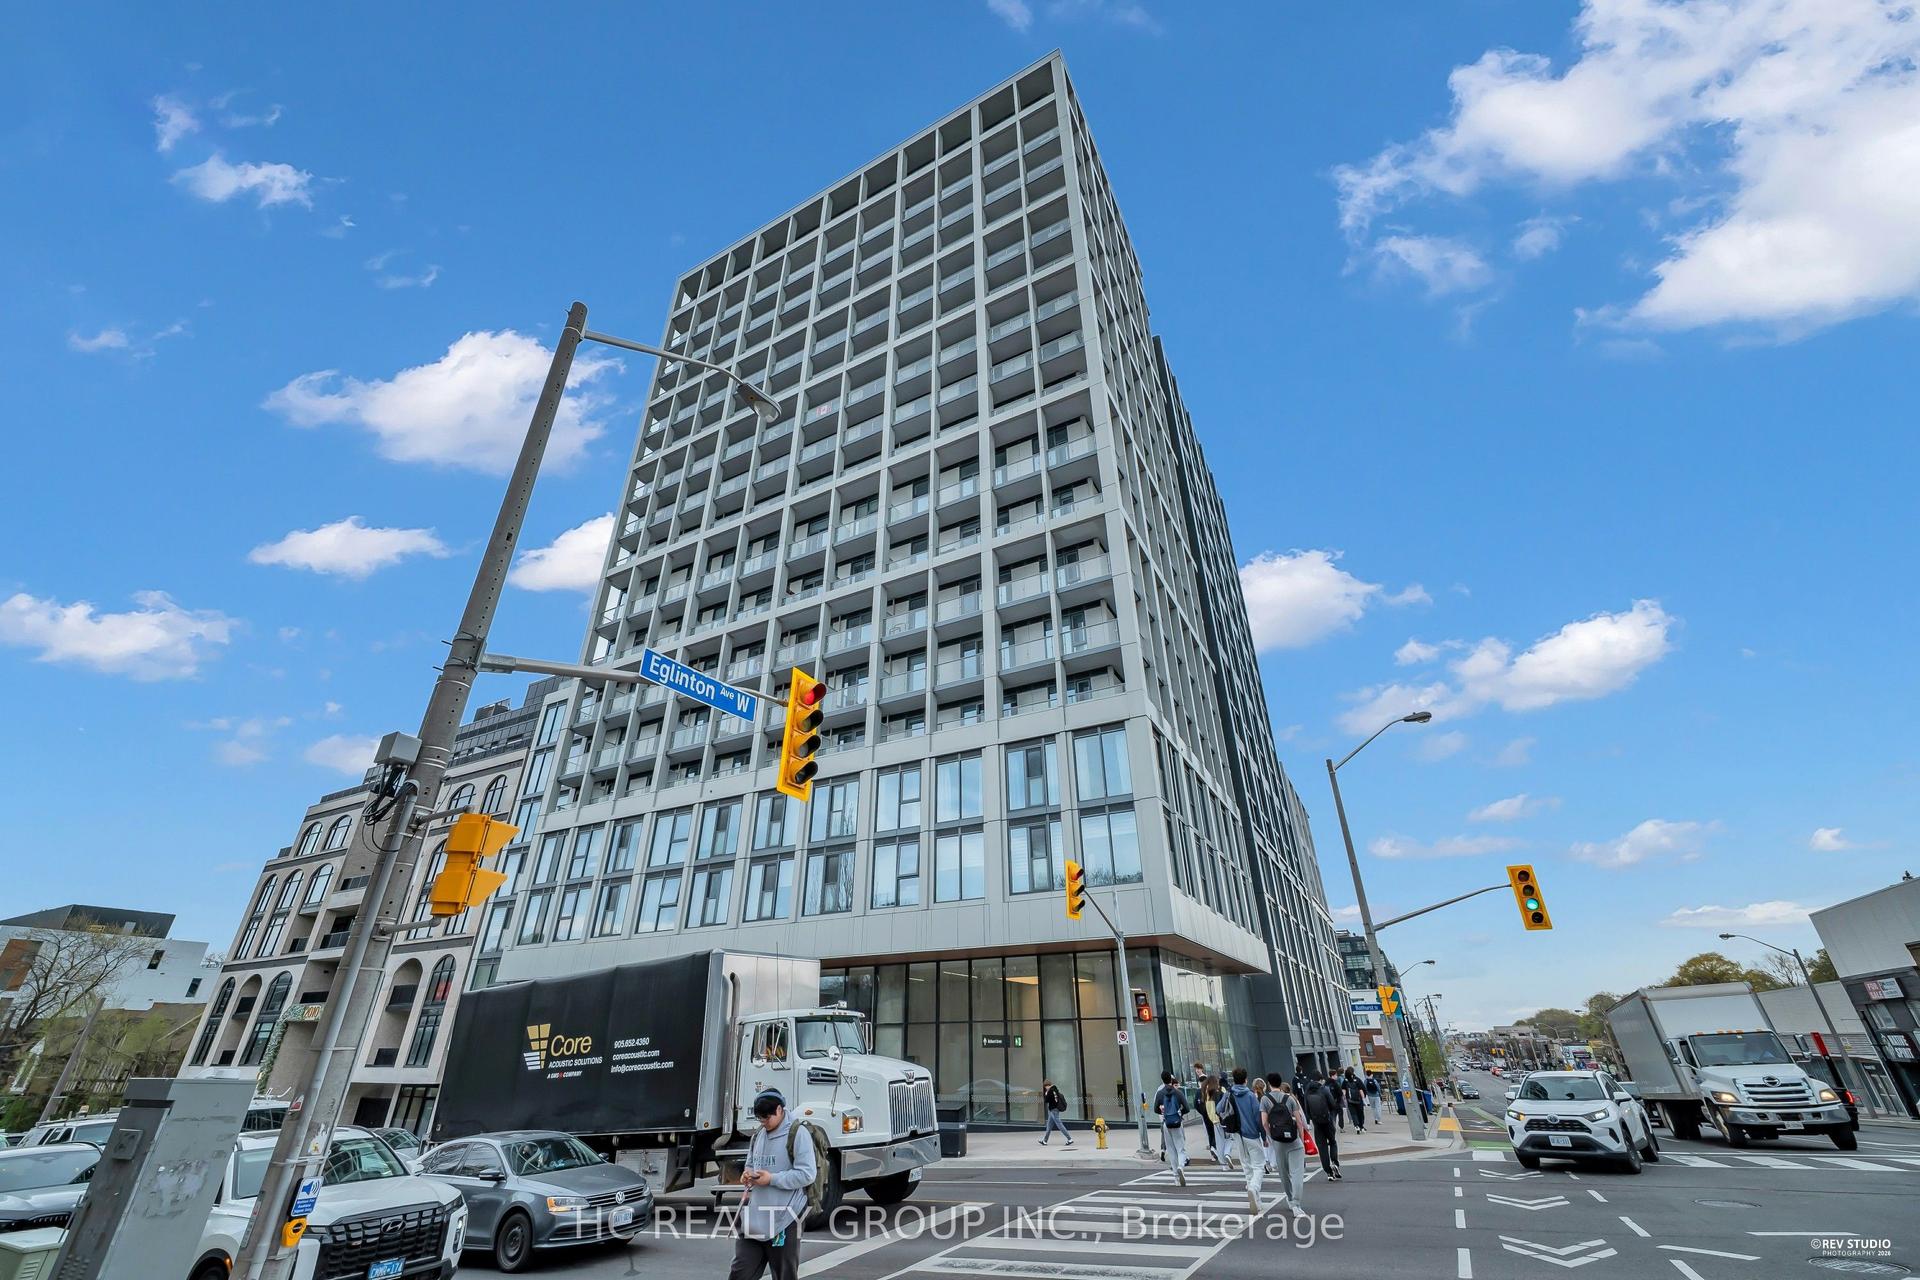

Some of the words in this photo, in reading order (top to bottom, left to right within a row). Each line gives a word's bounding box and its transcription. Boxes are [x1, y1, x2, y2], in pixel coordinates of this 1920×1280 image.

[649, 654, 715, 701] Eglinton
[720, 687, 734, 700] Ave
[736, 692, 749, 713] W
[551, 1034, 593, 1057] Core
[612, 1049, 660, 1061] coreacoustic.com
[548, 1058, 573, 1069] ACOUSTIC
[574, 1056, 603, 1067] SOLUTIONS
[610, 1060, 674, 1074] info@coreacoustic.com
[563, 1070, 582, 1078] COMPANY
